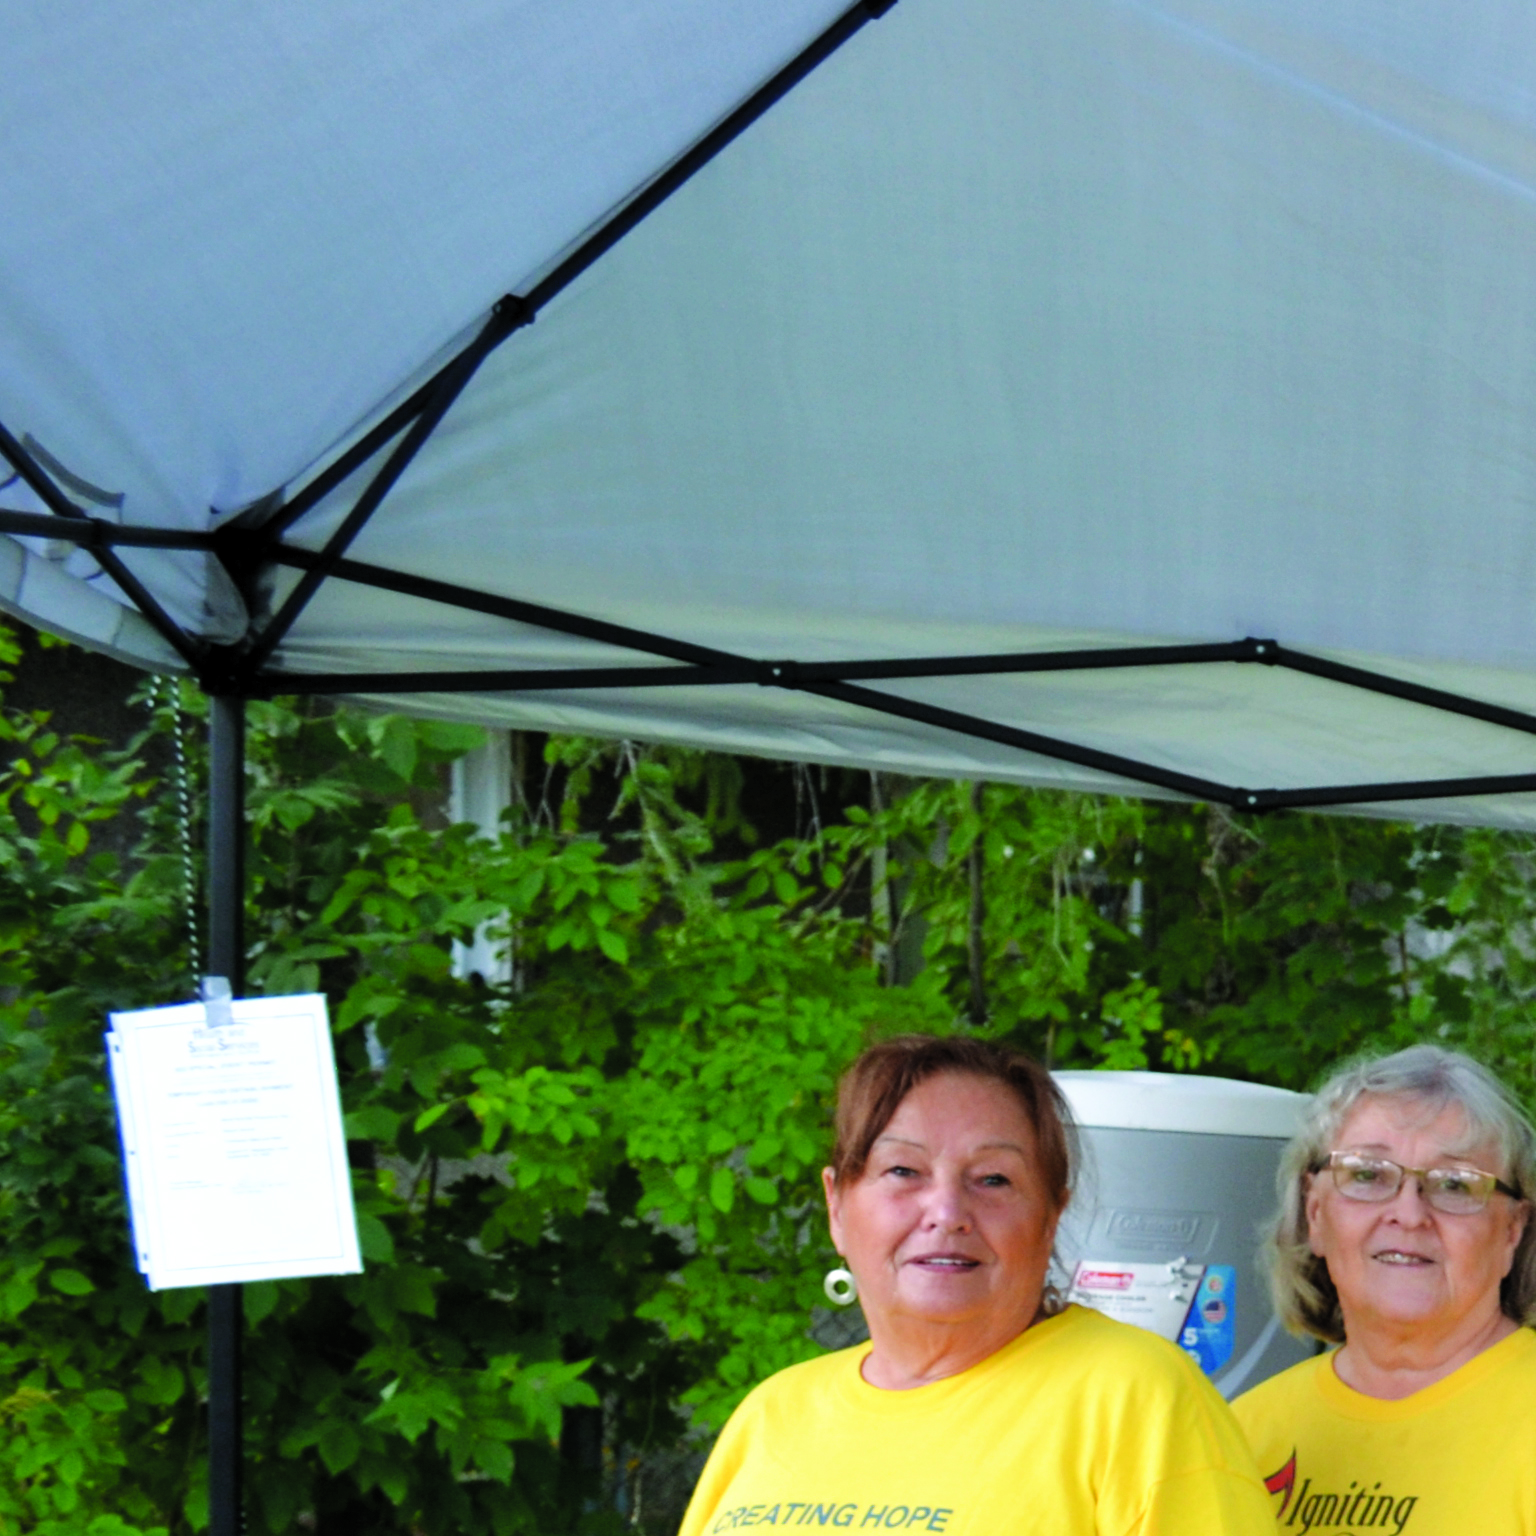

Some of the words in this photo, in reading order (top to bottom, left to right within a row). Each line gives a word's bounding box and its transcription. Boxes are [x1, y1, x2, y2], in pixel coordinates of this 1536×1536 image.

[713, 1503, 858, 1534] CREATING
[859, 1504, 954, 1533] HOPE
[1285, 1478, 1419, 1536] Igniting
